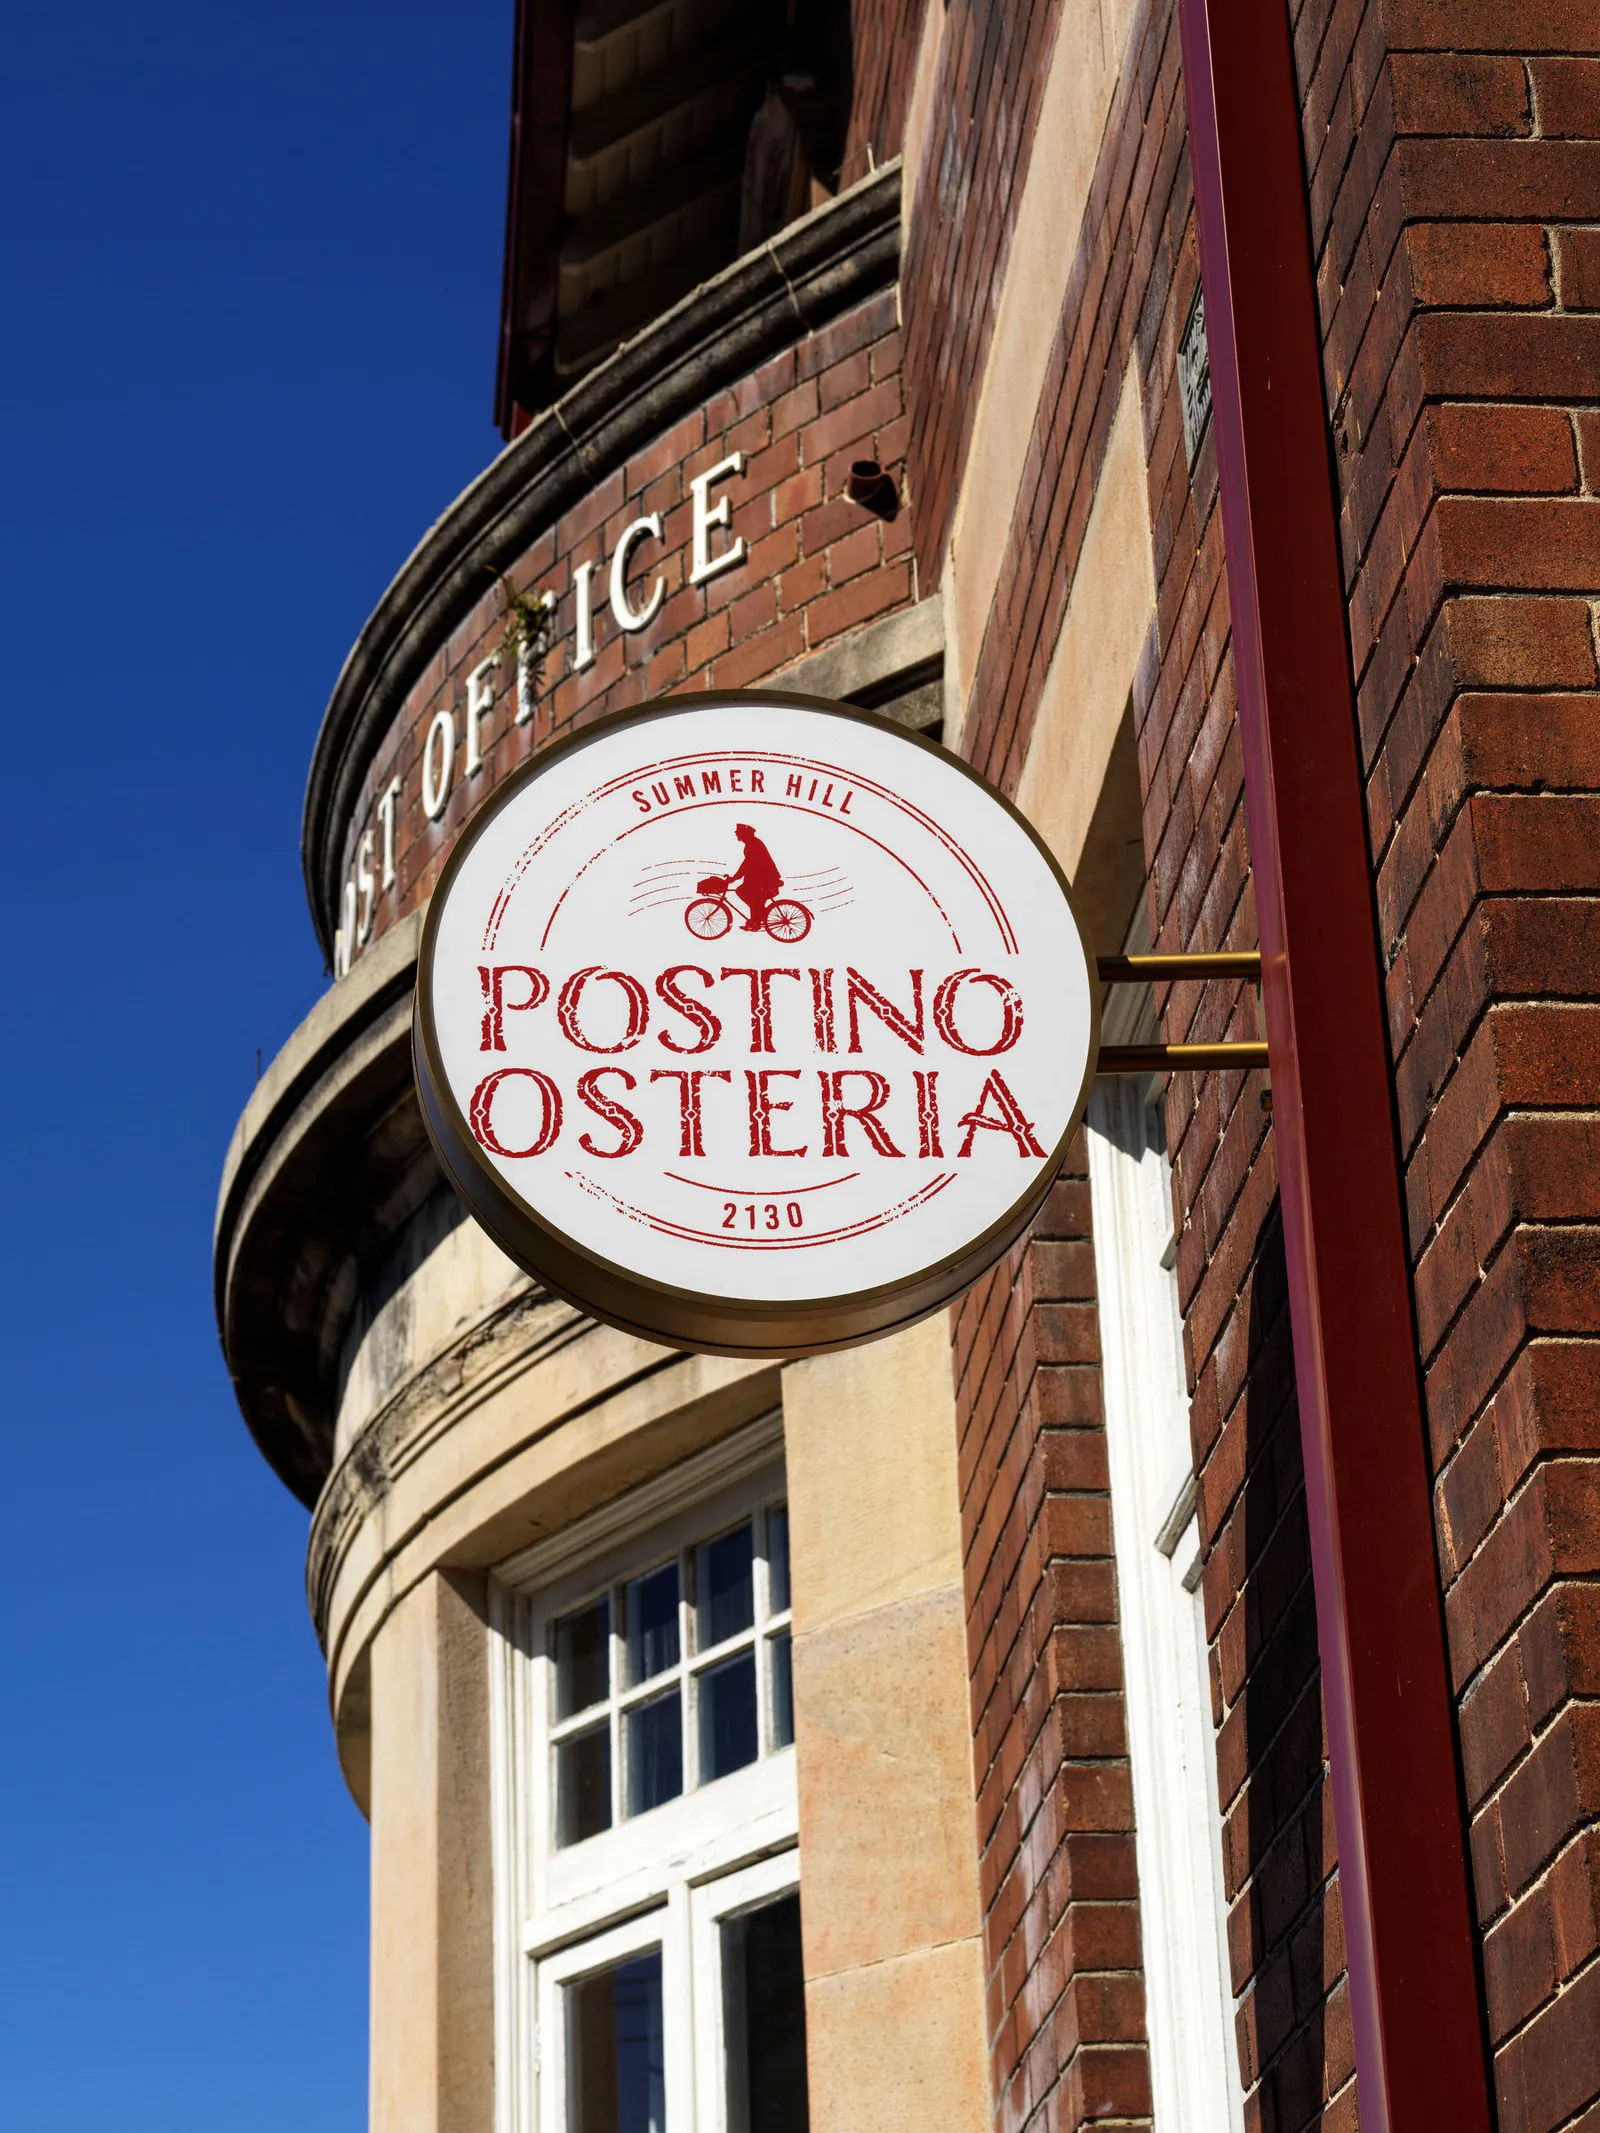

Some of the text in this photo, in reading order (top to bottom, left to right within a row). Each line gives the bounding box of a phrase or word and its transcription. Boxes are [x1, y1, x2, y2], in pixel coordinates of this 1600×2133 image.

[631, 769, 854, 815] SUMMER HILL
[477, 964, 1025, 1057] POSTINO
[469, 1066, 1049, 1159] OSTERIA
[722, 1201, 804, 1231] 2130
